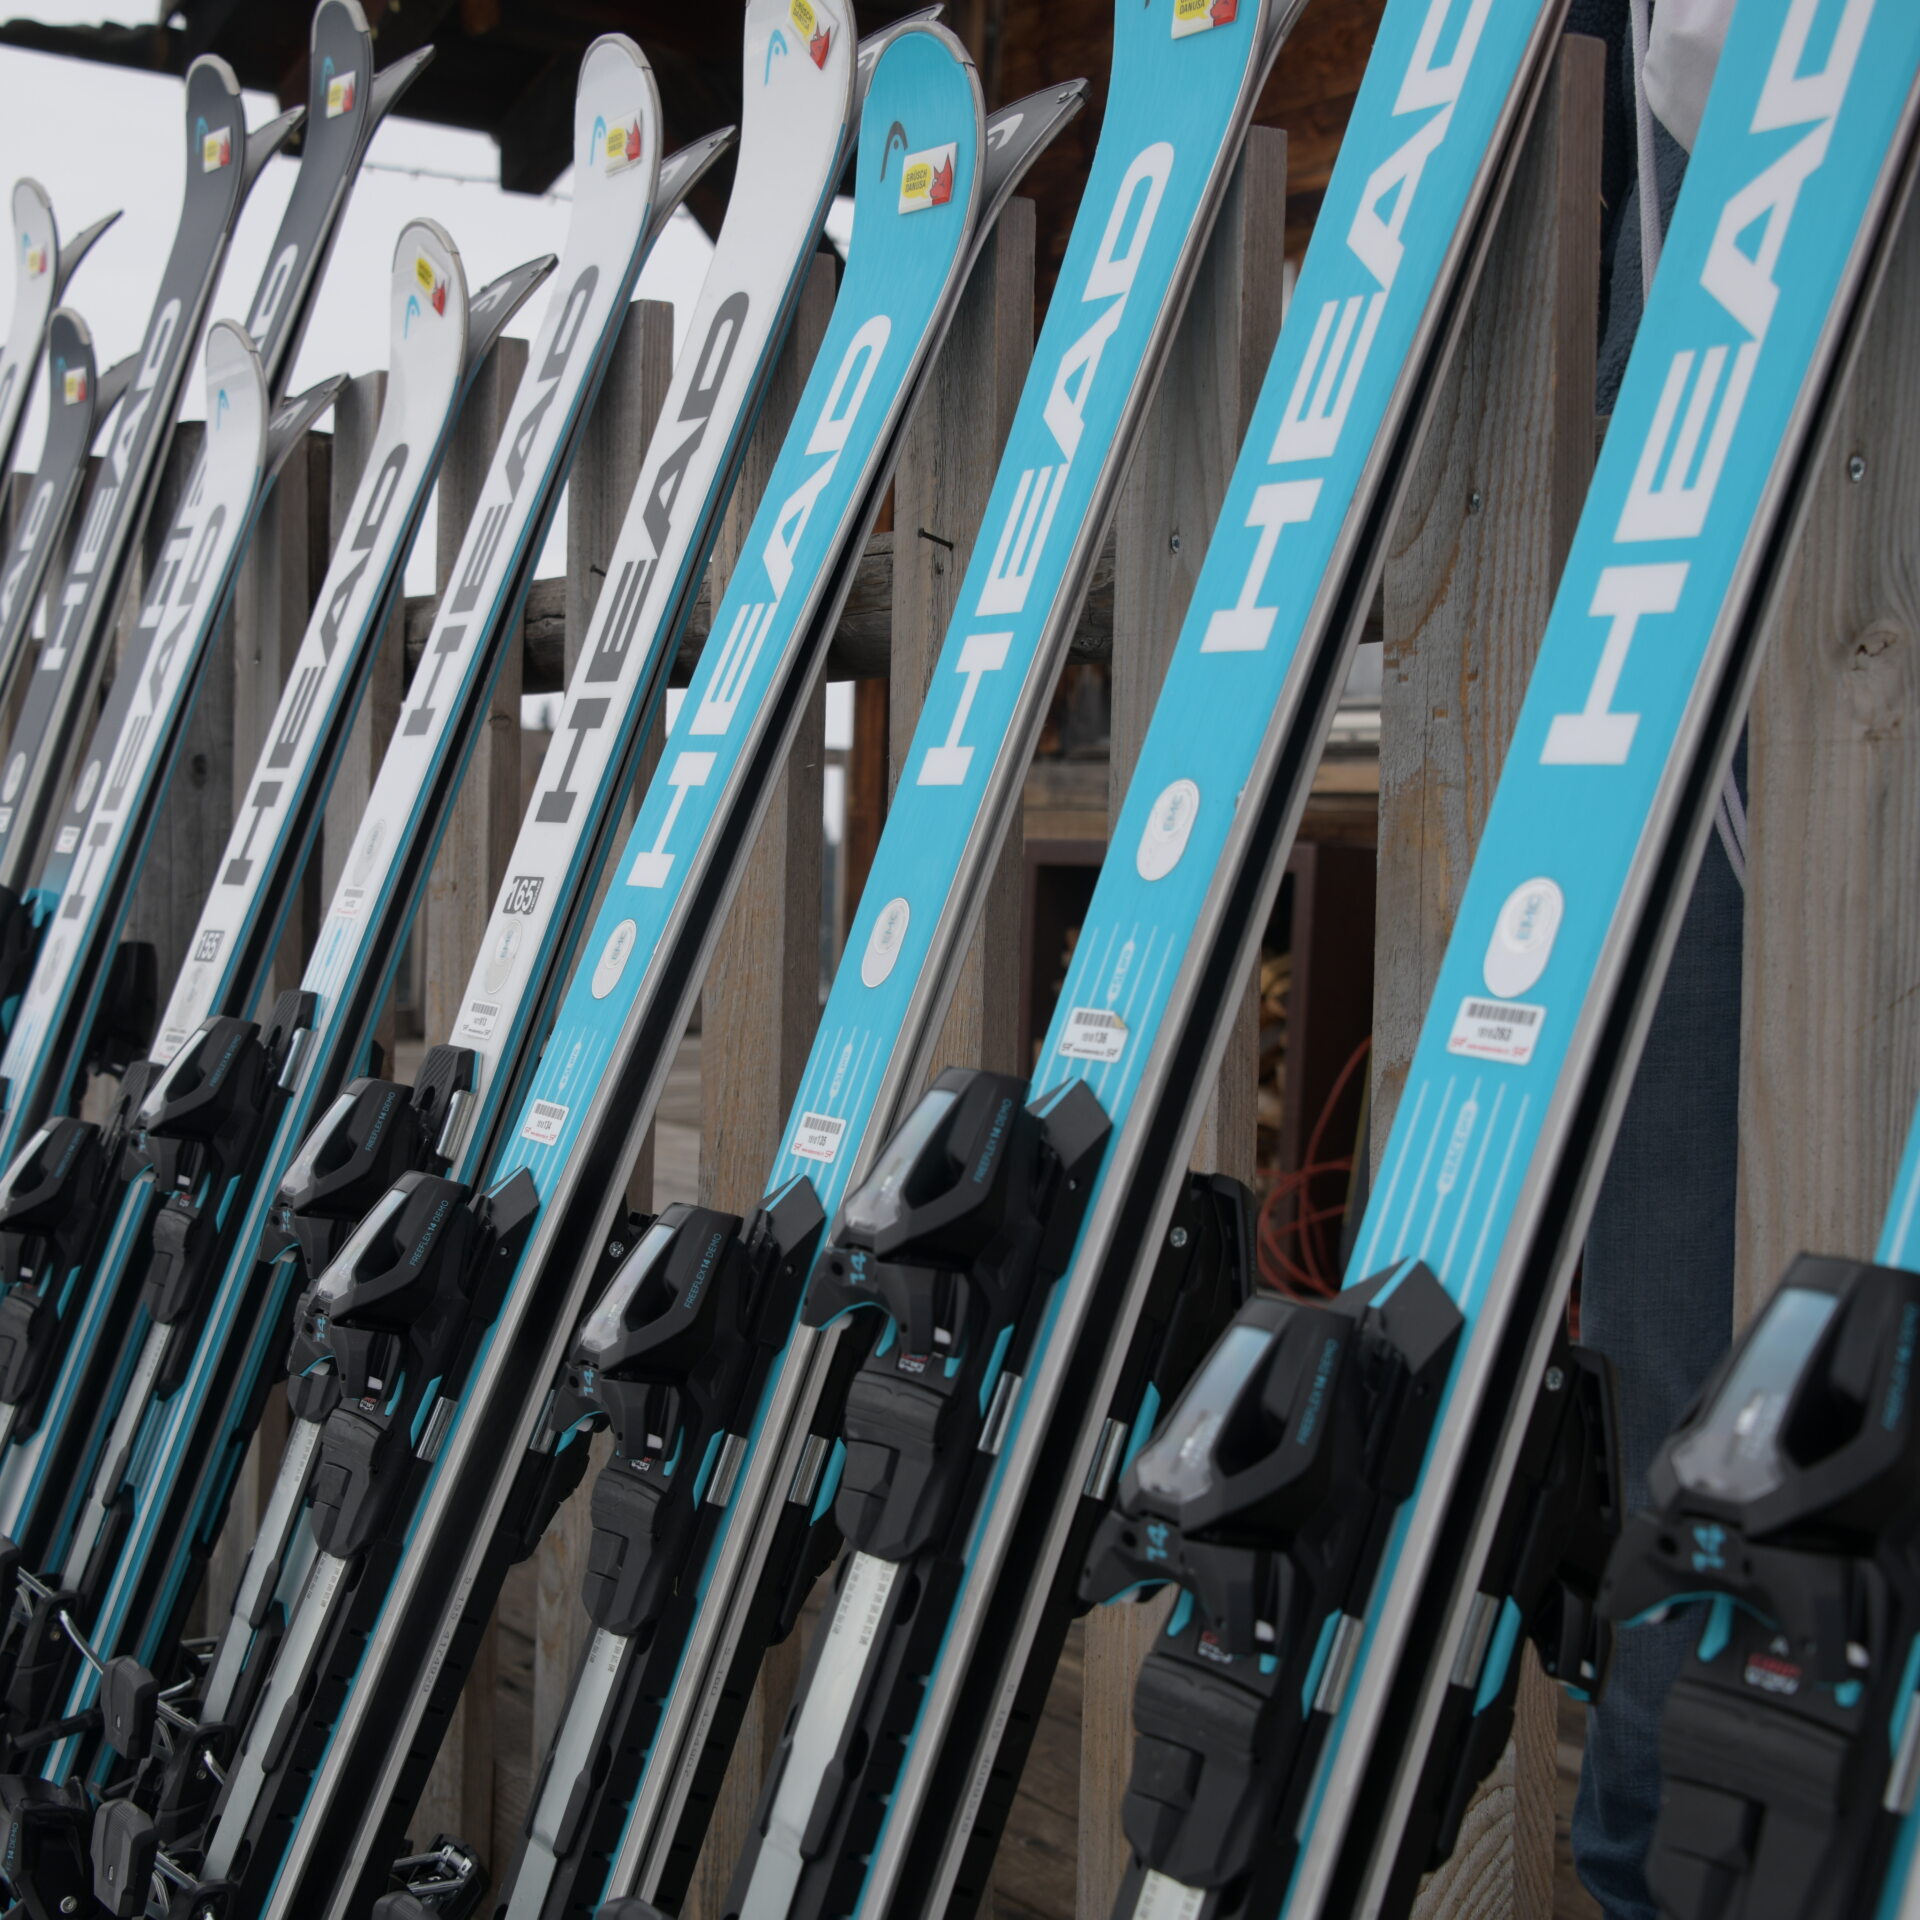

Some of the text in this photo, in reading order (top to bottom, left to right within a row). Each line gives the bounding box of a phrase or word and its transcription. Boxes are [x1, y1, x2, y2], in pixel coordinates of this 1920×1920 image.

[905, 182, 926, 193] DANUSA
[906, 169, 928, 182] GRÜSCH
[1198, 0, 1488, 653] HEAD
[1539, 0, 1875, 764] HEAD
[41, 298, 181, 670] HEAD
[917, 142, 1174, 786] HEAD
[402, 265, 599, 736] HEAD
[535, 292, 749, 824] HEAD
[626, 315, 891, 888] HEAD
[222, 443, 409, 886] HEAD
[62, 504, 226, 919] HEAD
[506, 878, 538, 912] 165
[196, 931, 221, 959] 155
[365, 1120, 384, 1151] FREEFLEX
[383, 1091, 396, 1111] DEMO
[409, 1200, 449, 1267] FREEFLEX 14 DEMO
[684, 1233, 722, 1309] FREEFLEX 14 DEMO
[850, 1252, 866, 1285] 14
[317, 1316, 326, 1341] 14
[583, 1368, 594, 1396] 14
[1146, 1522, 1168, 1561] 14
[1692, 1525, 1725, 1572] 14
